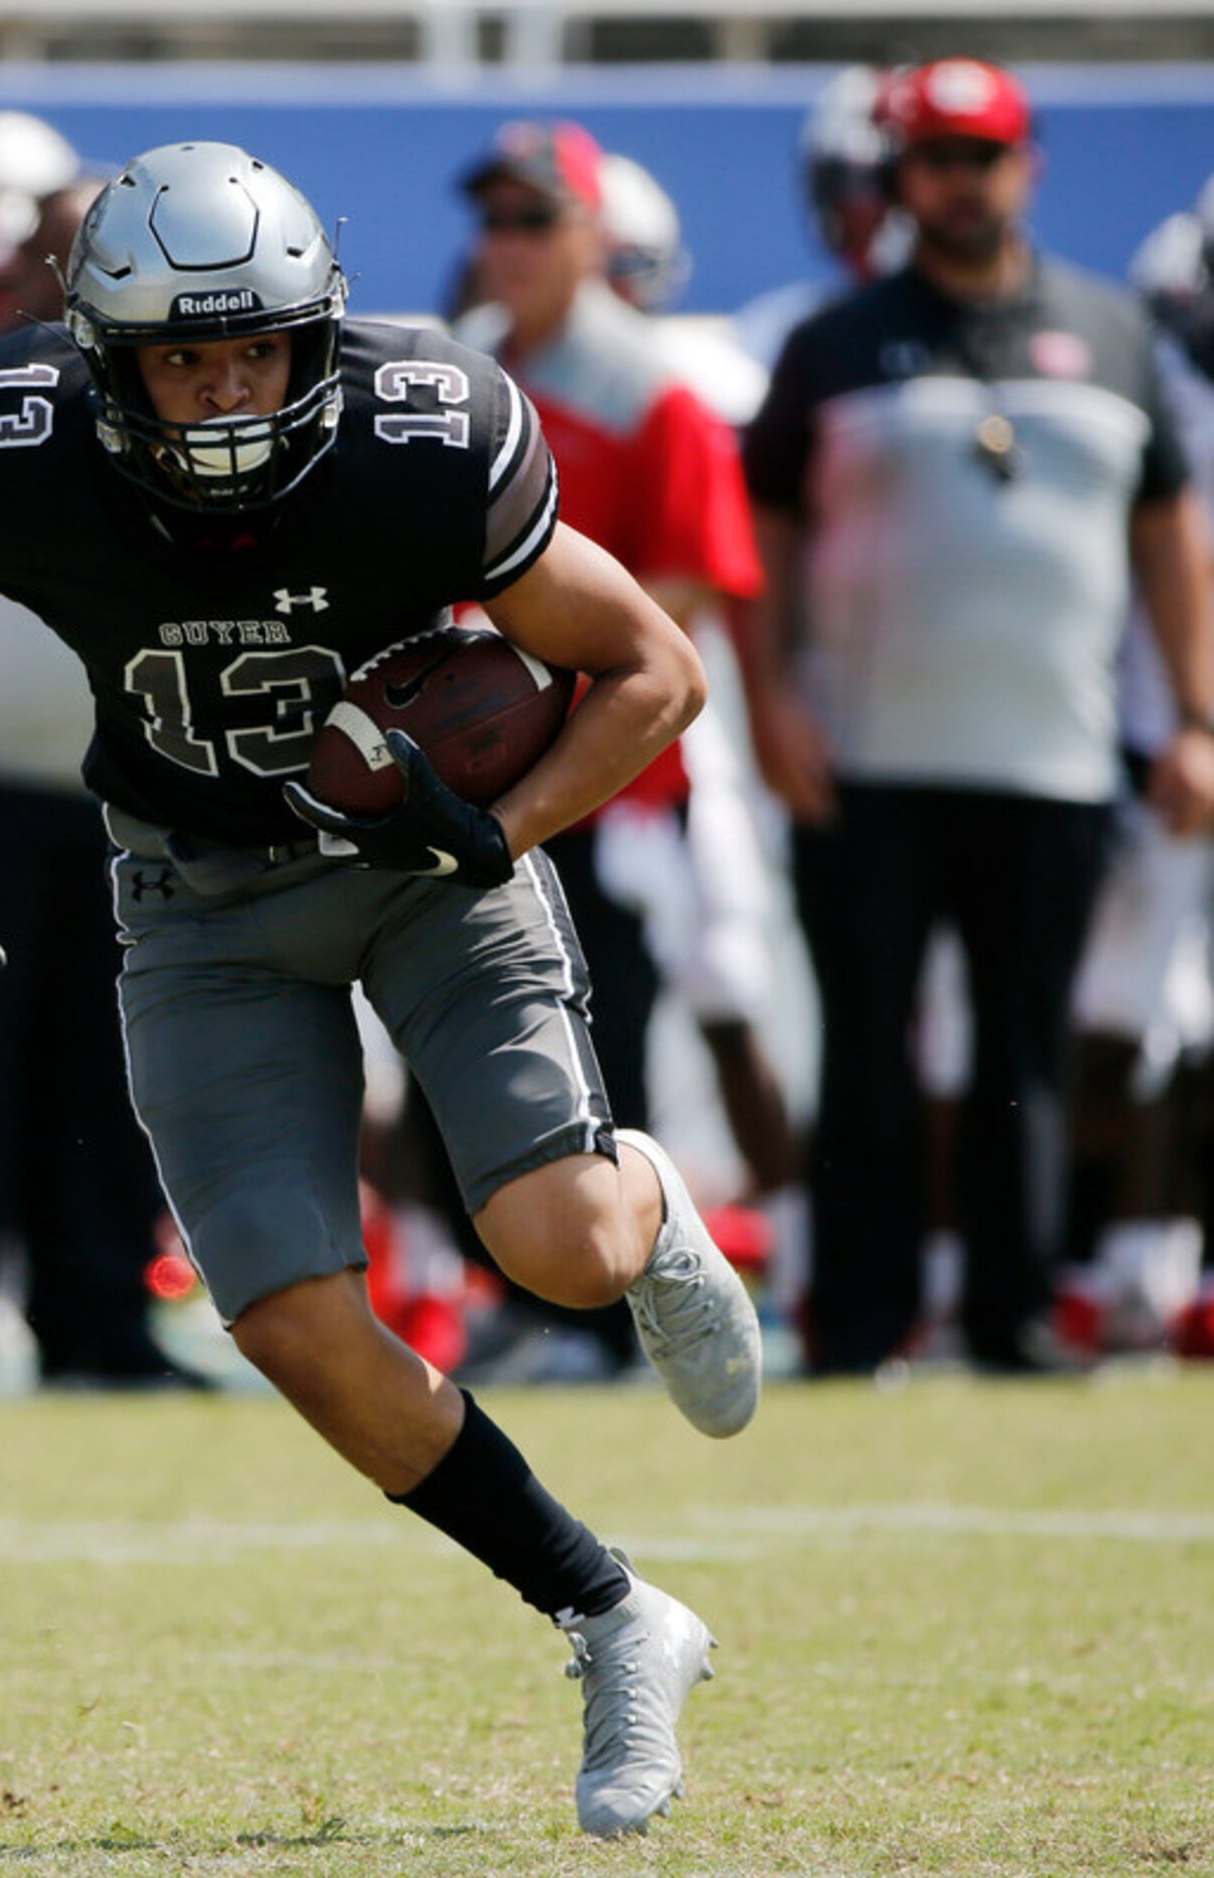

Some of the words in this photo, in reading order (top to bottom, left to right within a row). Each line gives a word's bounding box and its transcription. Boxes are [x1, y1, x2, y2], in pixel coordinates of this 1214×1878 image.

[179, 291, 253, 314] Riddell
[374, 360, 470, 450] 13
[158, 620, 292, 646] GUYER
[124, 645, 347, 778] 13
